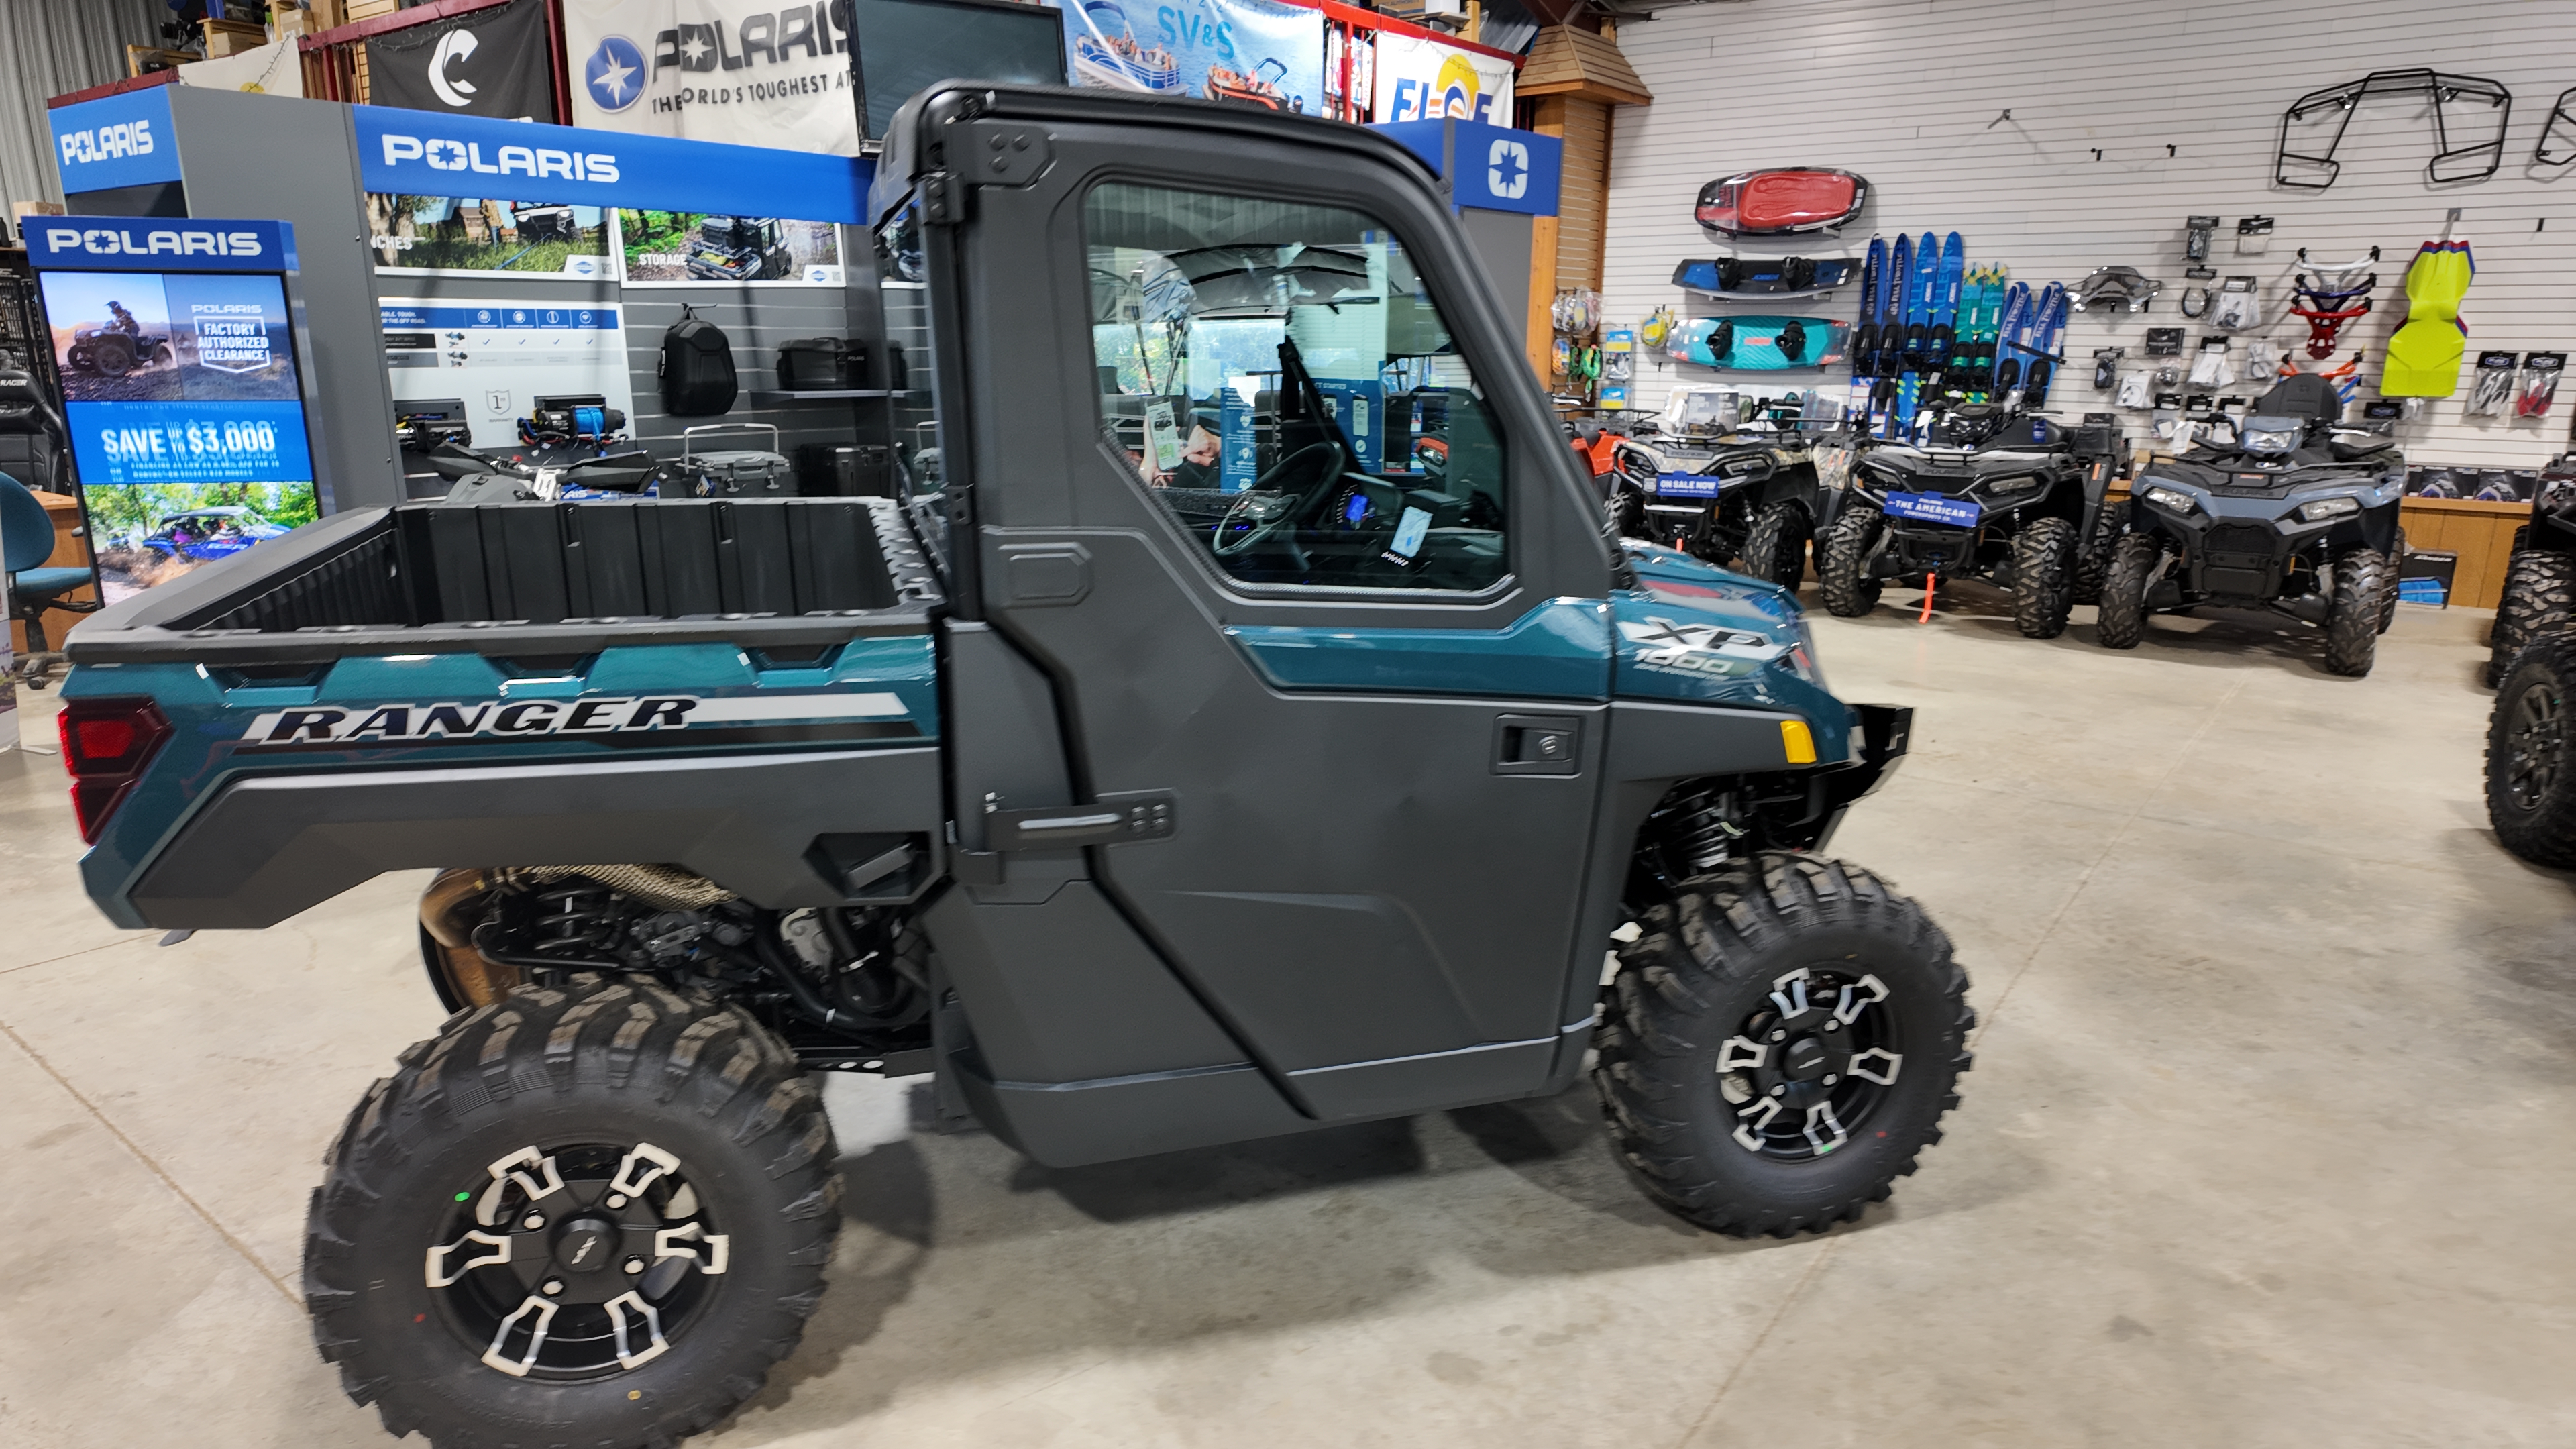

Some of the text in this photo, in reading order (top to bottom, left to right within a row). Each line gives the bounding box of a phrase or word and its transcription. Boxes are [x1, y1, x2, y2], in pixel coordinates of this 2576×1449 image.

[748, 74, 828, 101] TOUGHEST
[60, 119, 154, 166] POLARIS
[381, 133, 621, 183] POLARIS
[46, 229, 262, 256] POLARIS
[638, 253, 688, 266] STORAGE
[191, 304, 262, 314] POLARIS
[204, 323, 255, 335] FACTORY
[197, 336, 269, 349] AUTHORIZED
[205, 350, 266, 361] CLEARANCE
[101, 427, 166, 458] SAVE
[1660, 480, 1673, 489] ON
[1673, 480, 1695, 490] SALE
[1696, 481, 1717, 490] NOW
[1895, 500, 1968, 518] THE AMERICAN
[1635, 619, 1771, 651] XP
[1633, 648, 1735, 674] 1000
[262, 695, 699, 745] RANGER
